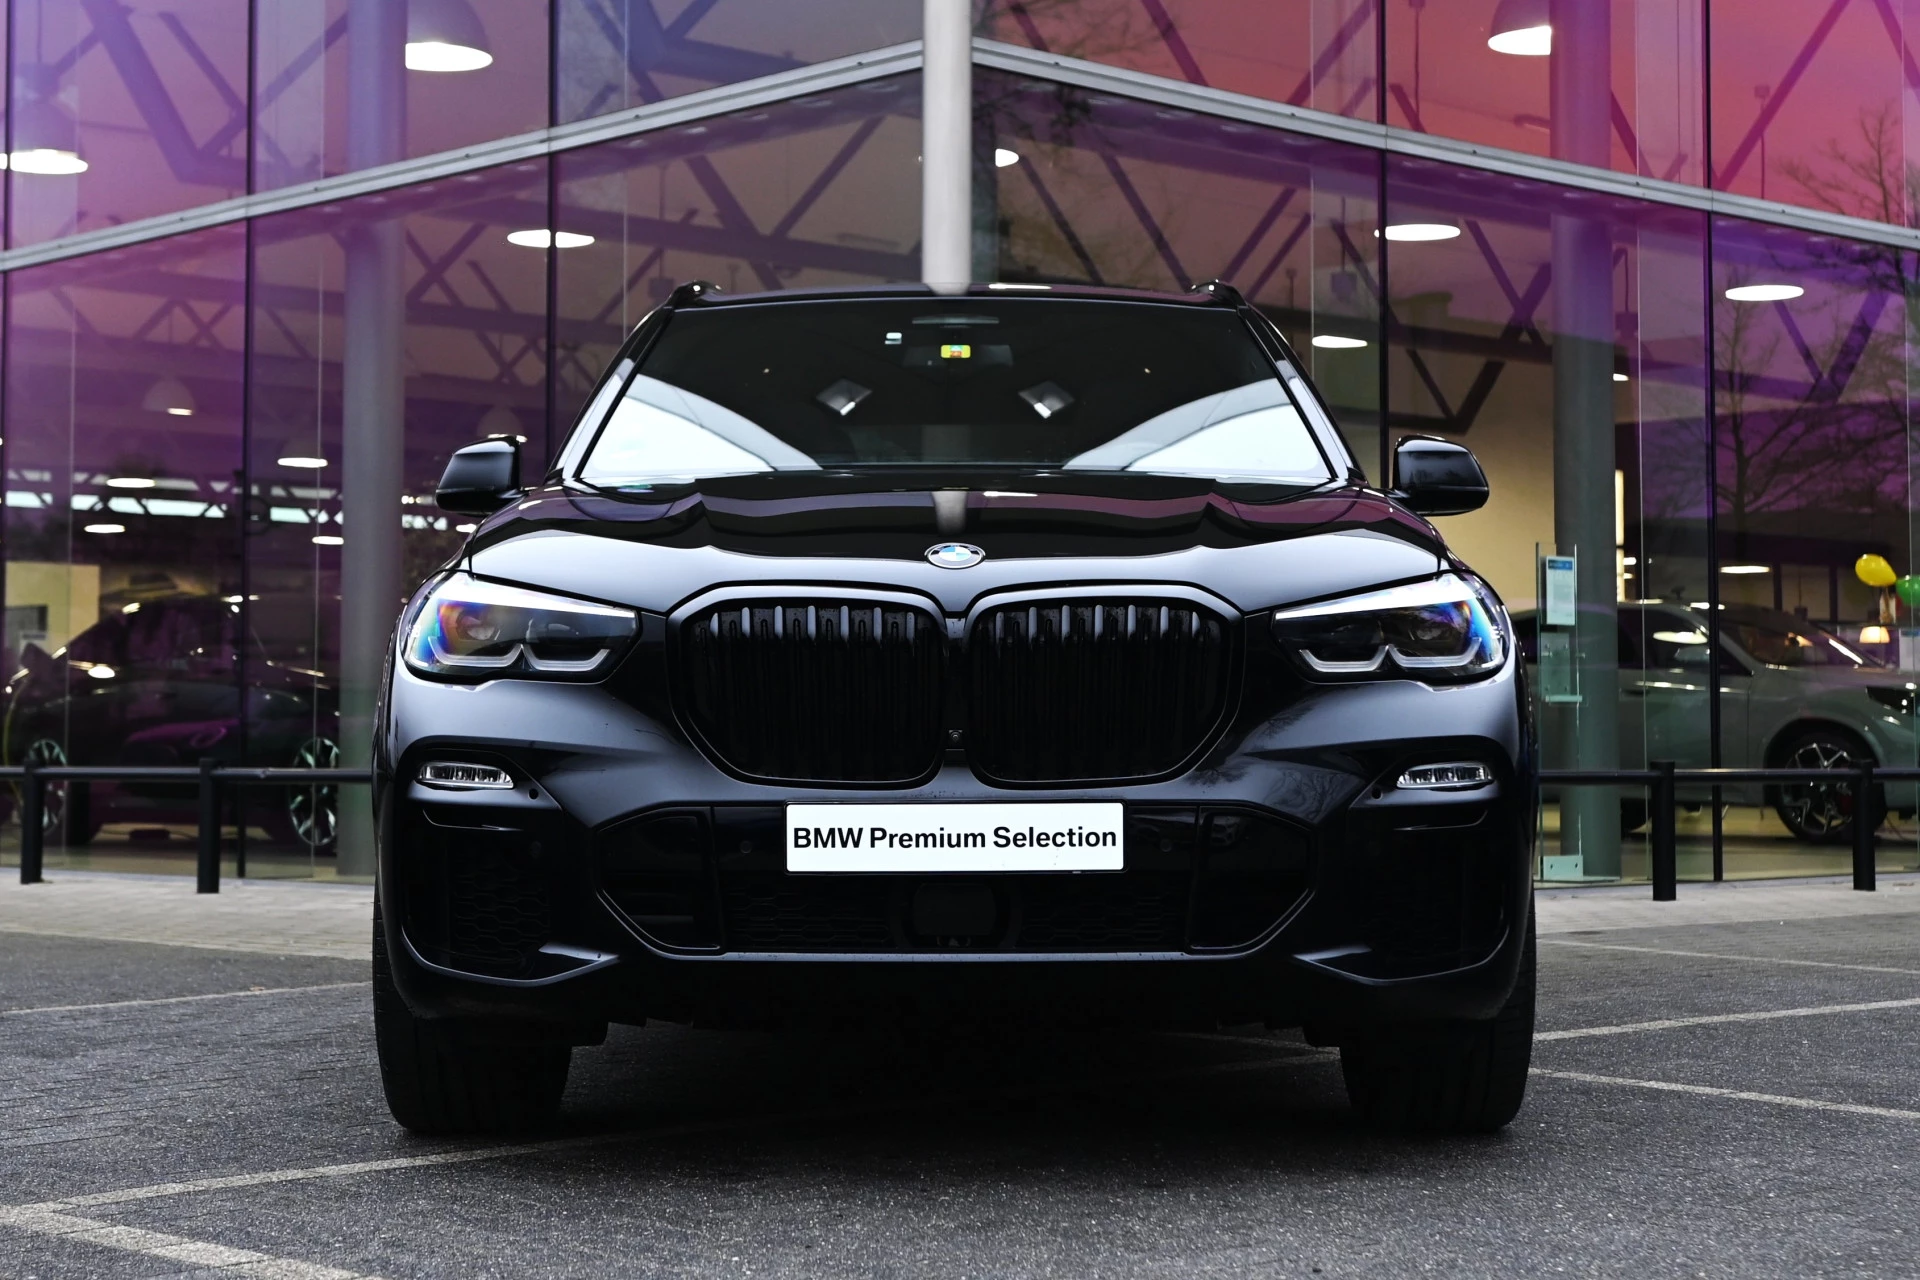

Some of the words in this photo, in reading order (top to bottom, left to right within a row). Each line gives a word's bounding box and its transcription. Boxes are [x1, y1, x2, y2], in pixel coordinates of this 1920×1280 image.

[793, 827, 864, 849] BMW
[870, 827, 986, 849] Premium
[993, 826, 1117, 848] Selection
